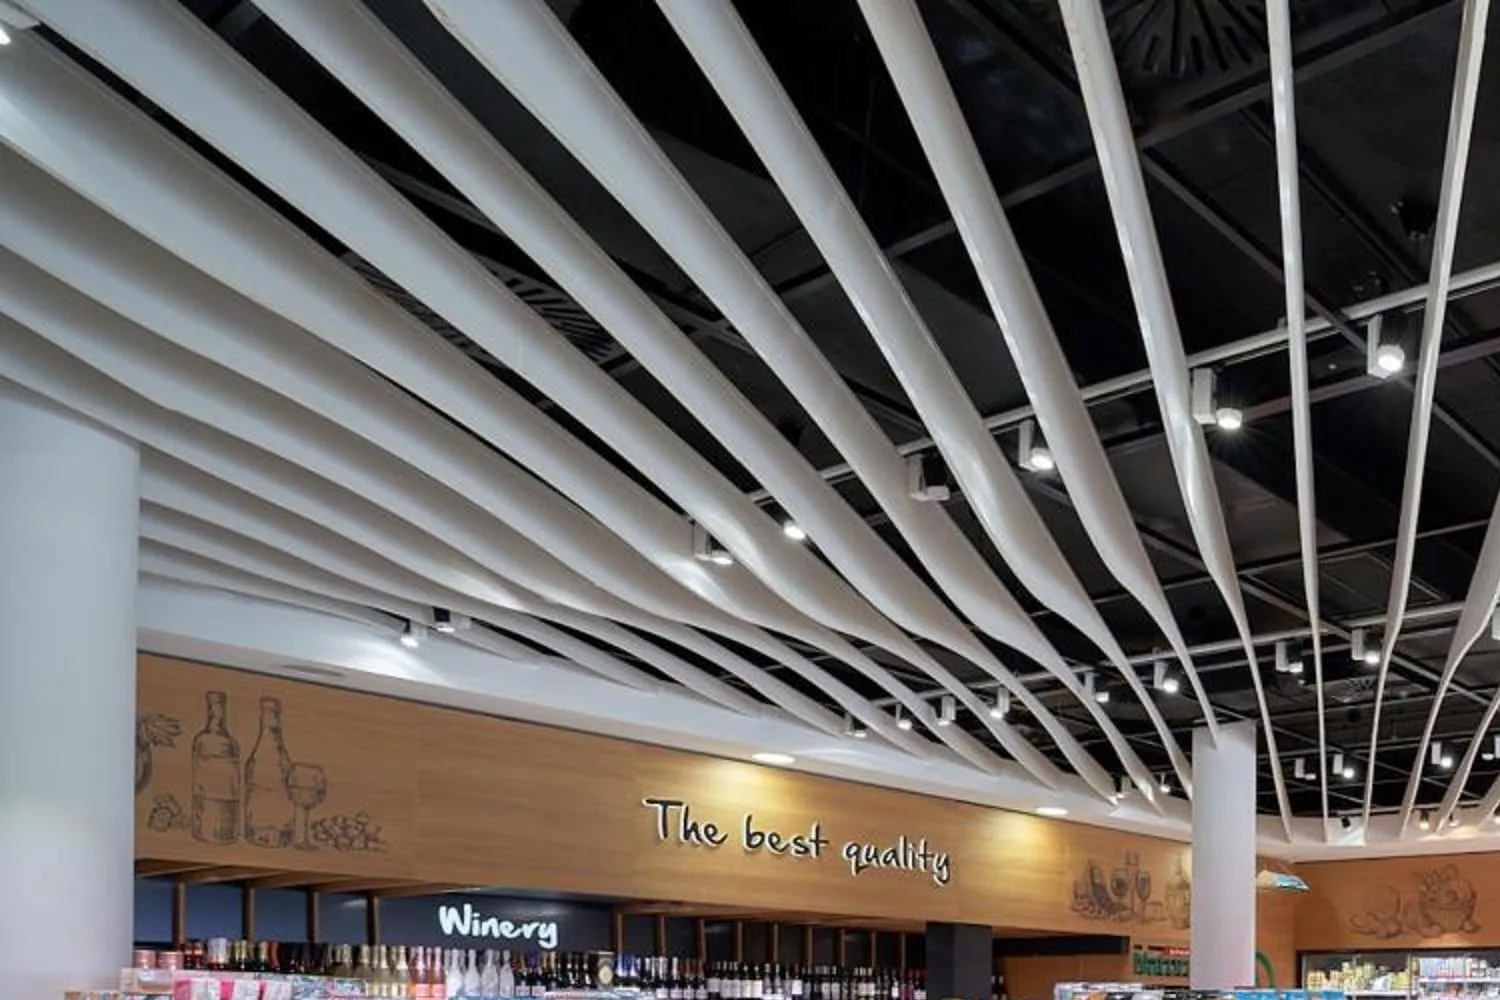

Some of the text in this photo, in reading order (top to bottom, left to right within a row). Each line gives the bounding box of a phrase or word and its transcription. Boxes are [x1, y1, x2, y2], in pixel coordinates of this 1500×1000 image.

[643, 798, 949, 886] The best quality
[439, 903, 558, 949] Winery
